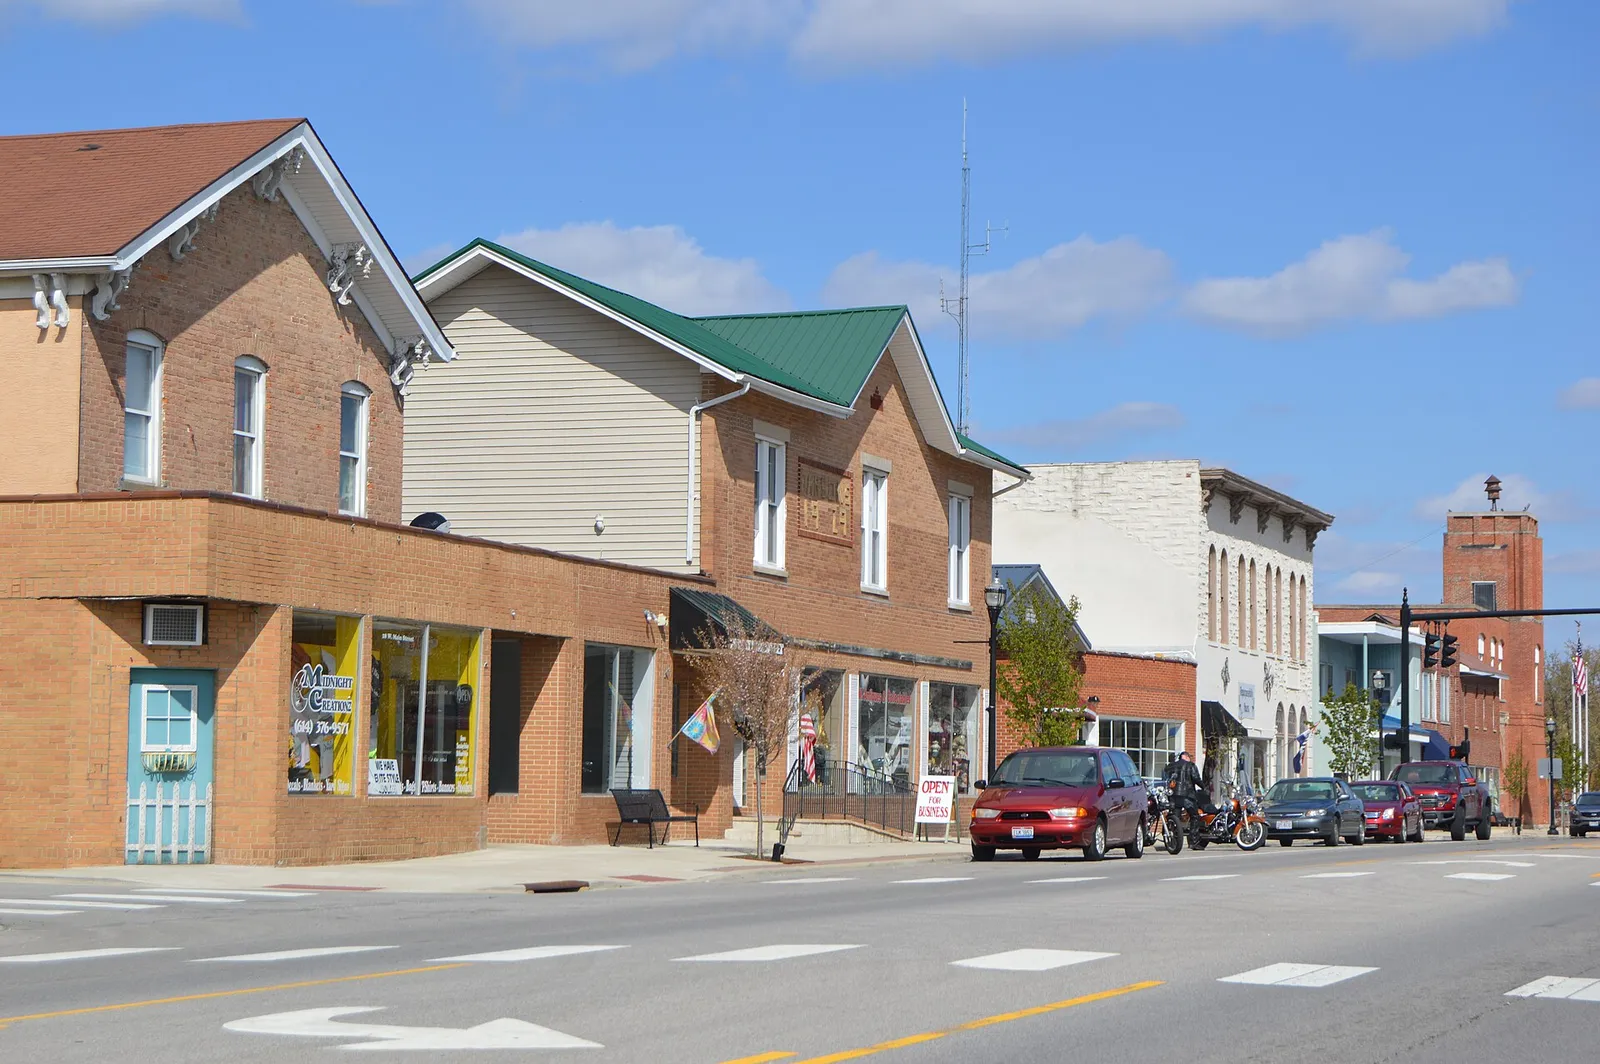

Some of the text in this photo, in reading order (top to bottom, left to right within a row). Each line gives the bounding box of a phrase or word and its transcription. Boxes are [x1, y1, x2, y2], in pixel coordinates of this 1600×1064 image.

[302, 663, 353, 689] MIDNIGHT
[294, 718, 349, 736] (614) 376-9571
[375, 760, 395, 770] WE HAVE
[921, 780, 950, 794] OPEN
[928, 796, 941, 804] FOR
[918, 805, 949, 818] BUSINESS
